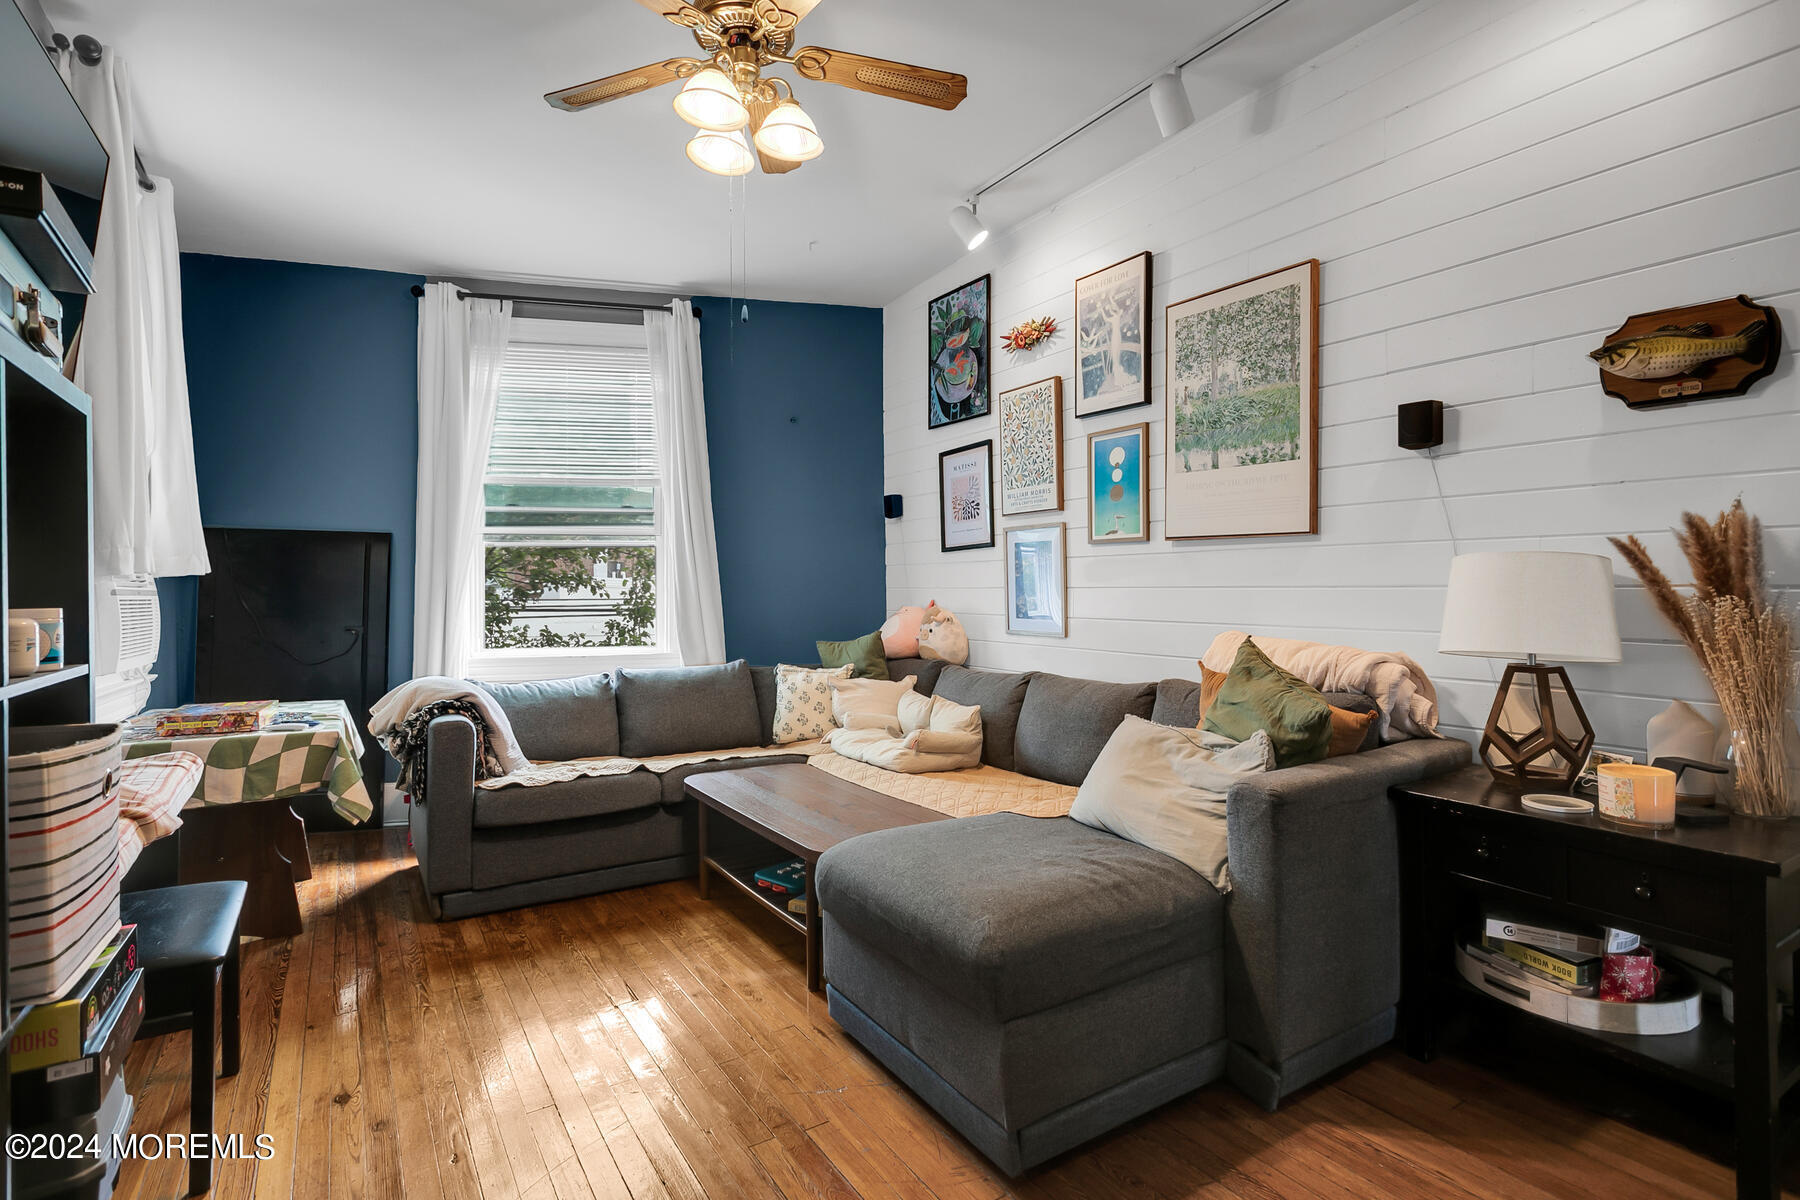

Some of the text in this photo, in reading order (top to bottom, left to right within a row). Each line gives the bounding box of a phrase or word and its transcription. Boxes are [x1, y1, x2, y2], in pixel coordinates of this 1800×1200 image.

[1007, 490, 1029, 500] WILLIAM
[1030, 487, 1052, 497] MORRIS
[1524, 952, 1549, 968] WORLD
[1552, 963, 1572, 978] BOOK
